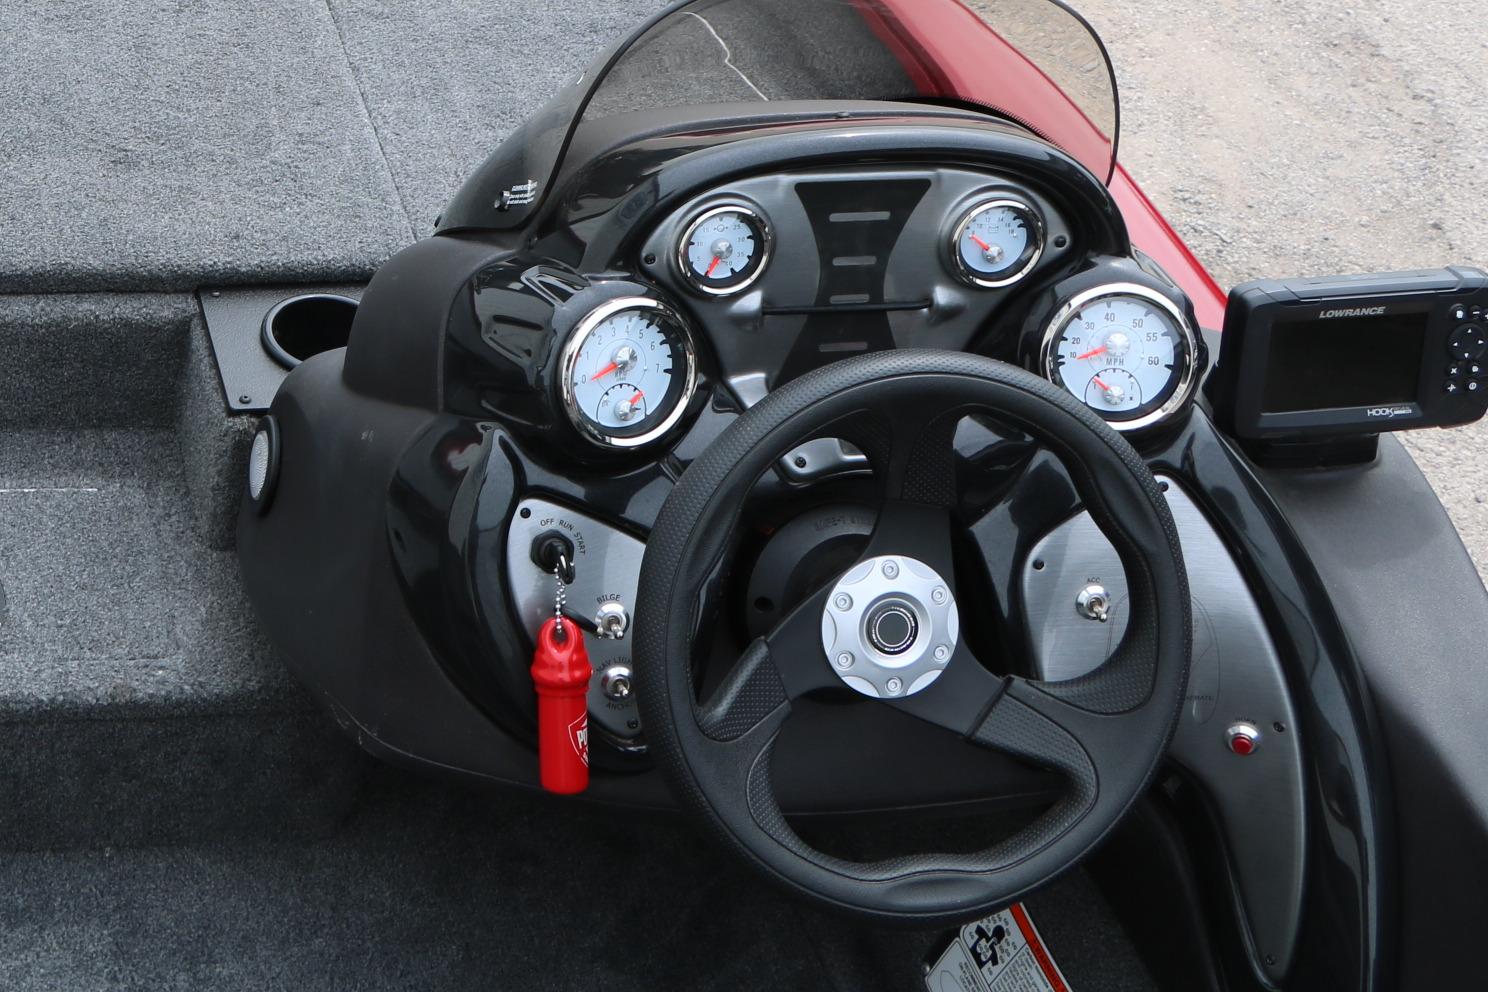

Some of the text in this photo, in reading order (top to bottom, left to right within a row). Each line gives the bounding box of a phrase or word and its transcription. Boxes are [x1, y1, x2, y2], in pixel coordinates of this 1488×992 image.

[1104, 312, 1115, 322] 40
[1318, 306, 1387, 319] LOWRANCE
[1085, 321, 1095, 330] 30
[1132, 318, 1144, 329] 50
[1071, 337, 1081, 345] 20
[1146, 332, 1158, 342] 55
[1105, 358, 1124, 366] MPH
[1147, 356, 1160, 366] 60
[540, 518, 586, 555] OFF RUN START
[596, 593, 621, 604] BILGE
